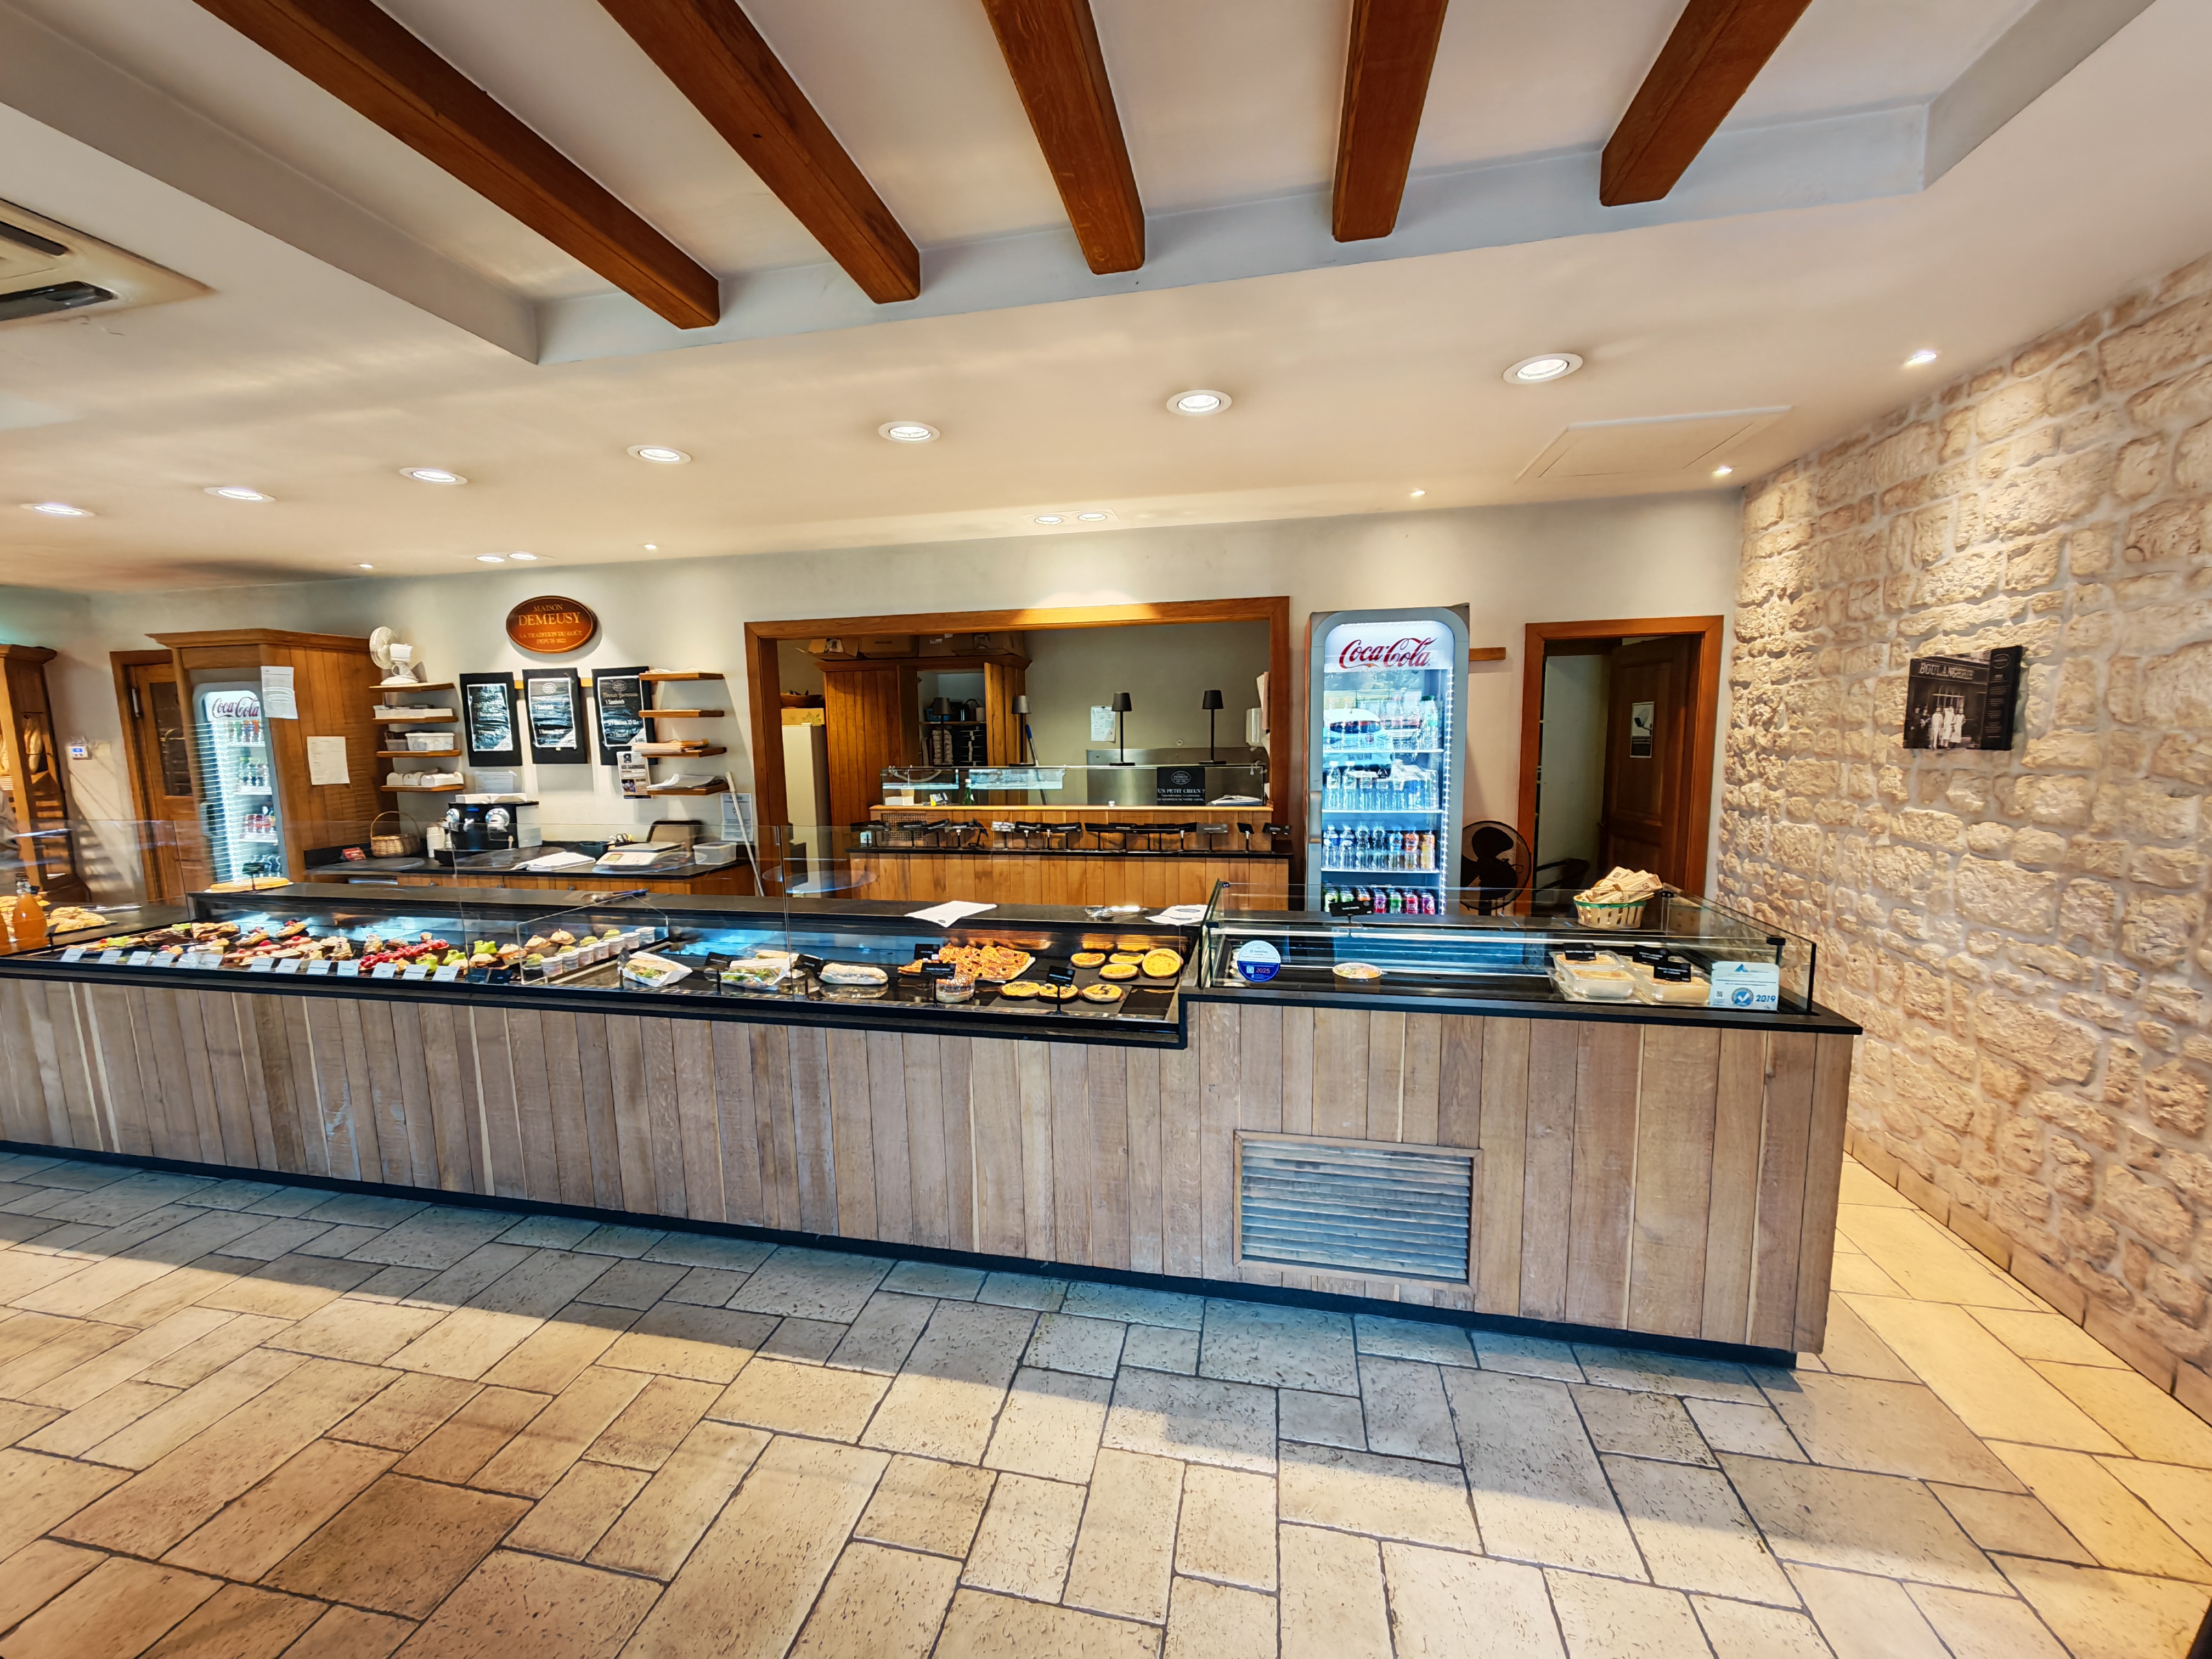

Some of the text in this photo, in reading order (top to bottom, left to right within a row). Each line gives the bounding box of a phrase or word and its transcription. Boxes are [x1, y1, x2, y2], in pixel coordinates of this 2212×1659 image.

[518, 612, 581, 626] DEMEUSY
[1339, 637, 1438, 669] Coca-Cola
[212, 696, 259, 719] Coca-Cola
